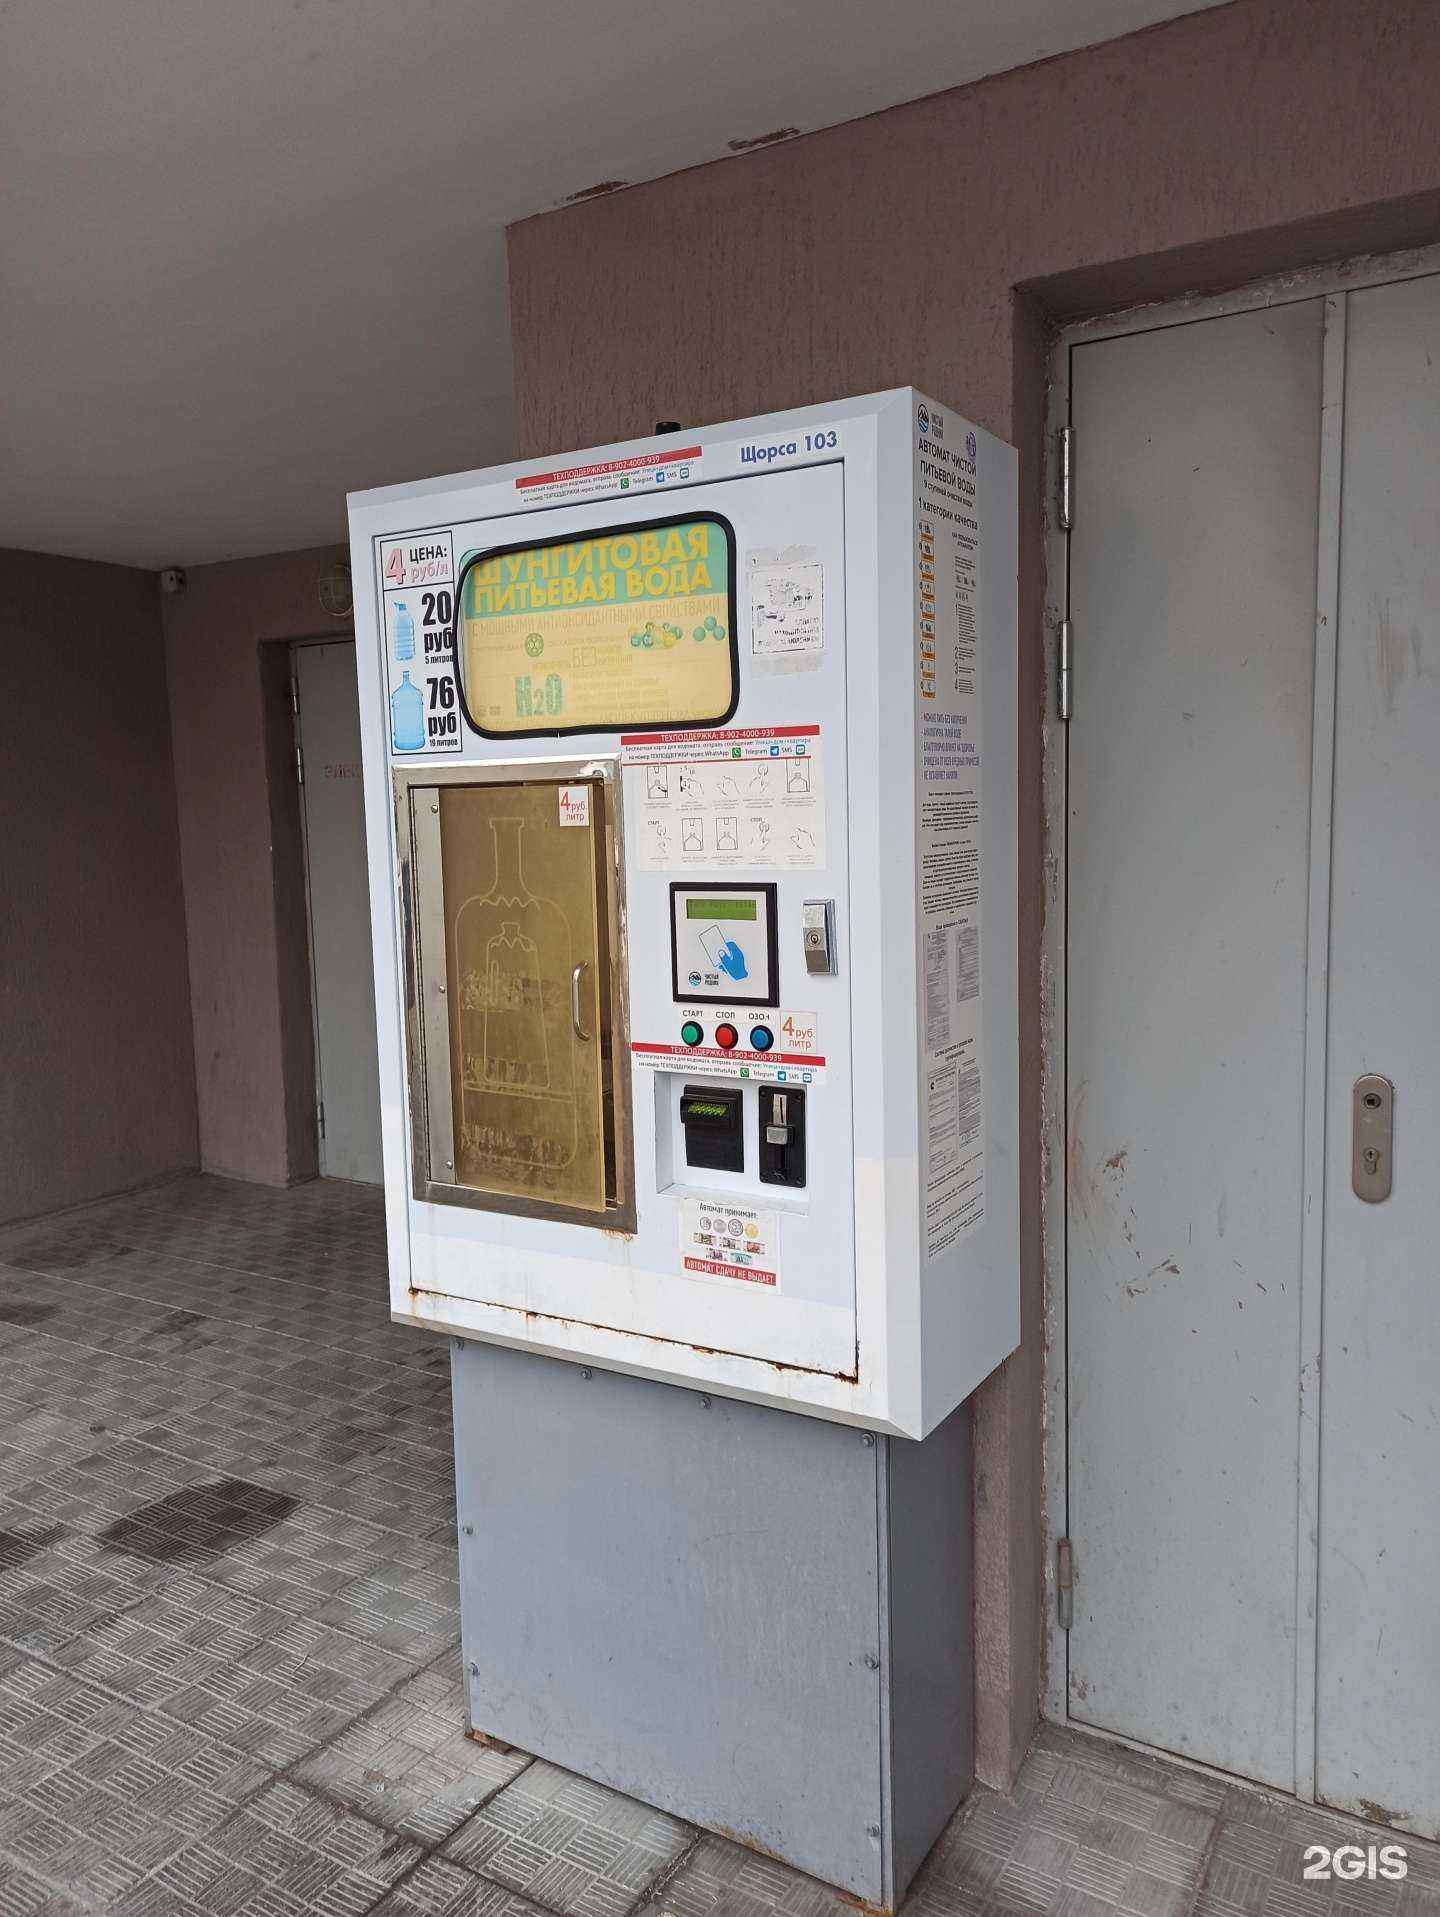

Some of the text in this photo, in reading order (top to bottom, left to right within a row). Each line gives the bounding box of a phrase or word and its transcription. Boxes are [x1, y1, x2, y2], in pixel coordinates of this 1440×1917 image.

[741, 430, 838, 464] Щорса 103
[919, 437, 950, 462] АВТОМАТ
[951, 453, 976, 477] ЧИСТОЙ
[552, 455, 660, 482] ТЕХПОДДЕРЖКА: 8-902-4000-939
[920, 460, 976, 496] ПИТЬЕВОЙ ВОДЫ
[918, 497, 922, 508] 1
[954, 513, 978, 530] качества
[386, 545, 448, 585] 4 ЦЕНА:
[410, 561, 449, 583] руб/л
[474, 560, 713, 614] ПИТЬЕВАЯ ВОДА
[421, 592, 452, 627] 20
[424, 628, 454, 654] руб
[424, 655, 430, 664] 5
[426, 676, 455, 710] 76
[428, 713, 457, 737] руб
[660, 728, 775, 743] ТЕХПОДДЕРЖКА: 8-902-4000-939
[430, 738, 458, 747] 19 литров
[705, 750, 729, 759] WhatsApp
[745, 748, 768, 756] Telegram
[561, 791, 571, 811] 4
[566, 813, 585, 822] литр
[682, 1009, 704, 1018] СТАРТ
[715, 1011, 736, 1019] СТОП
[782, 1017, 795, 1036] 4
[670, 1046, 782, 1062] ТЕХПОДДЕРЖКА: 8-902-4000-939
[788, 1039, 811, 1051] литр
[699, 1202, 759, 1219] Автомат принимает:
[687, 1259, 715, 1275] АВТОМАТ
[737, 1270, 748, 1278] НЕ
[747, 1271, 774, 1285] ВЫДАЕТ
